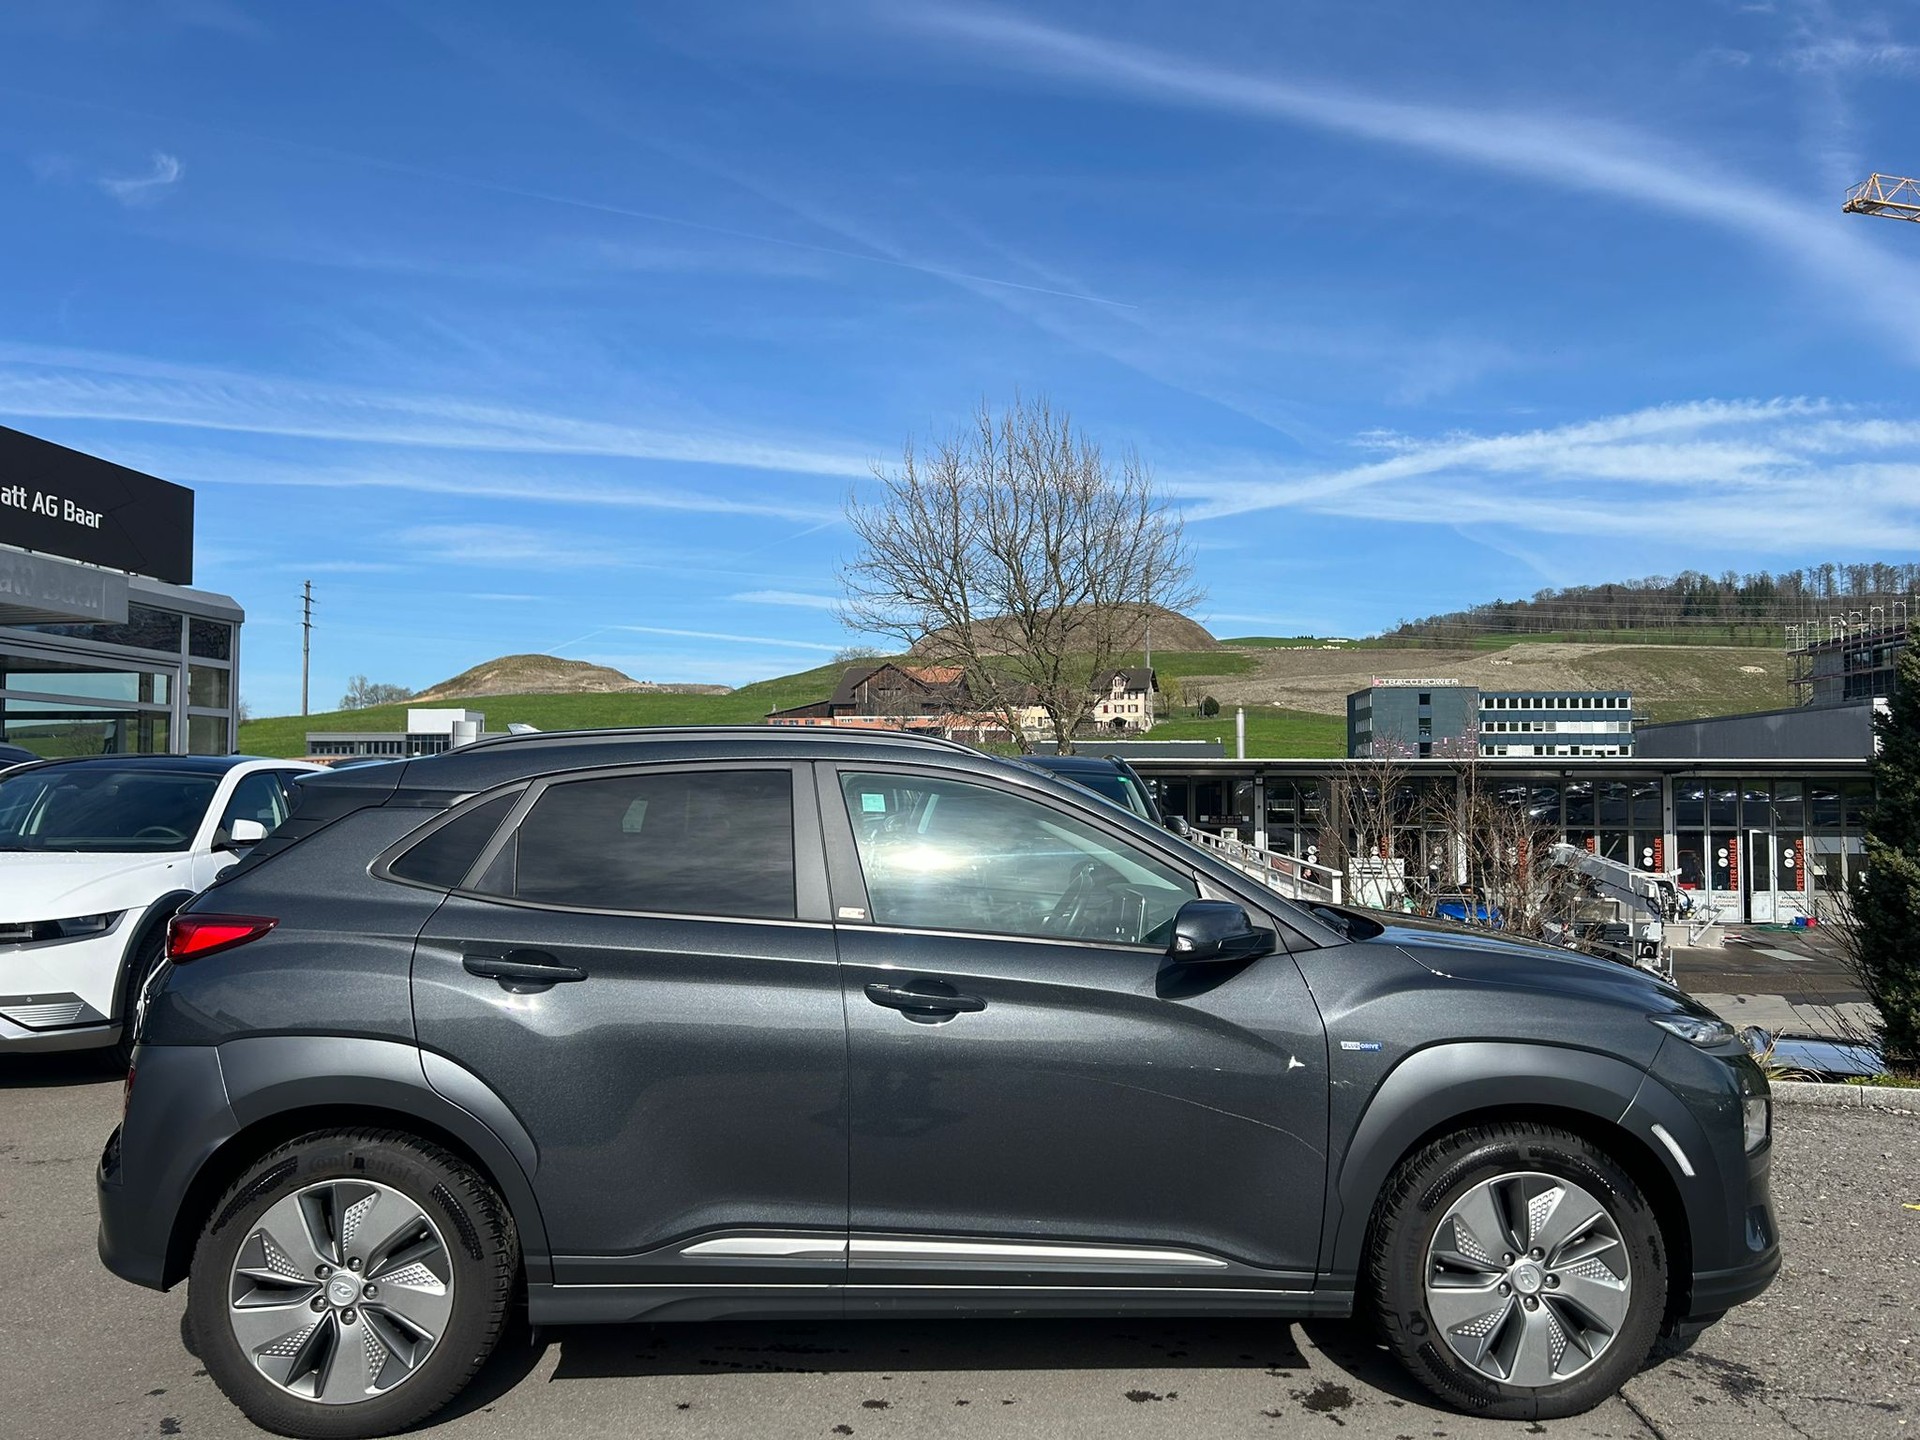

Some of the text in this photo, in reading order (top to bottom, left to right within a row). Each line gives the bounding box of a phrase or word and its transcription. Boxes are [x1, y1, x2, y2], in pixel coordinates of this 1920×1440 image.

[1, 485, 103, 529] att AG Baar
[1729, 868, 1738, 891] PETER
[1796, 869, 1804, 891] PETER
